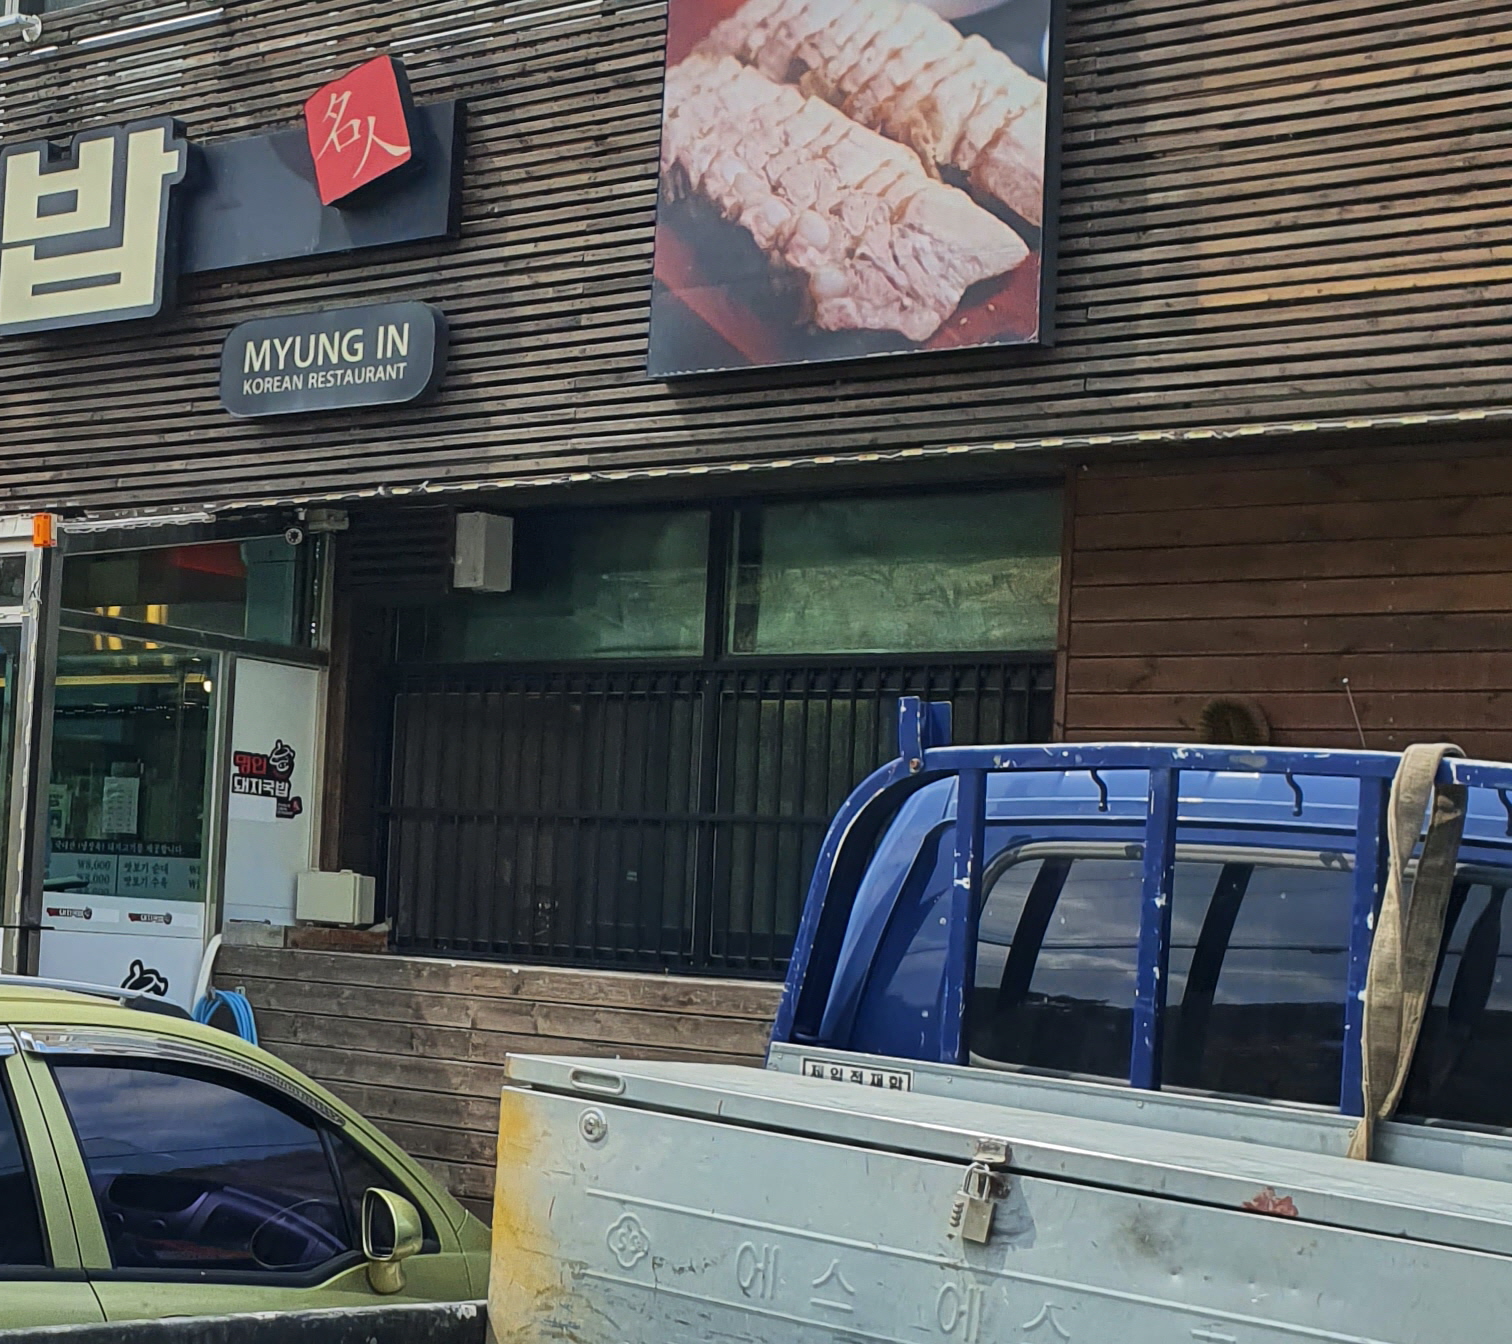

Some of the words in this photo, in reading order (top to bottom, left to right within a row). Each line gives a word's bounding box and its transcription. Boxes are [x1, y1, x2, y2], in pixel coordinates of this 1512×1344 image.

[313, 88, 411, 179] 名人
[243, 328, 364, 374] MYUNG
[376, 322, 410, 360] IN
[243, 373, 303, 396] KOREAN
[308, 362, 408, 389] RESTAURANT
[235, 754, 267, 775] 명인
[233, 775, 289, 798] 돼지국밥
